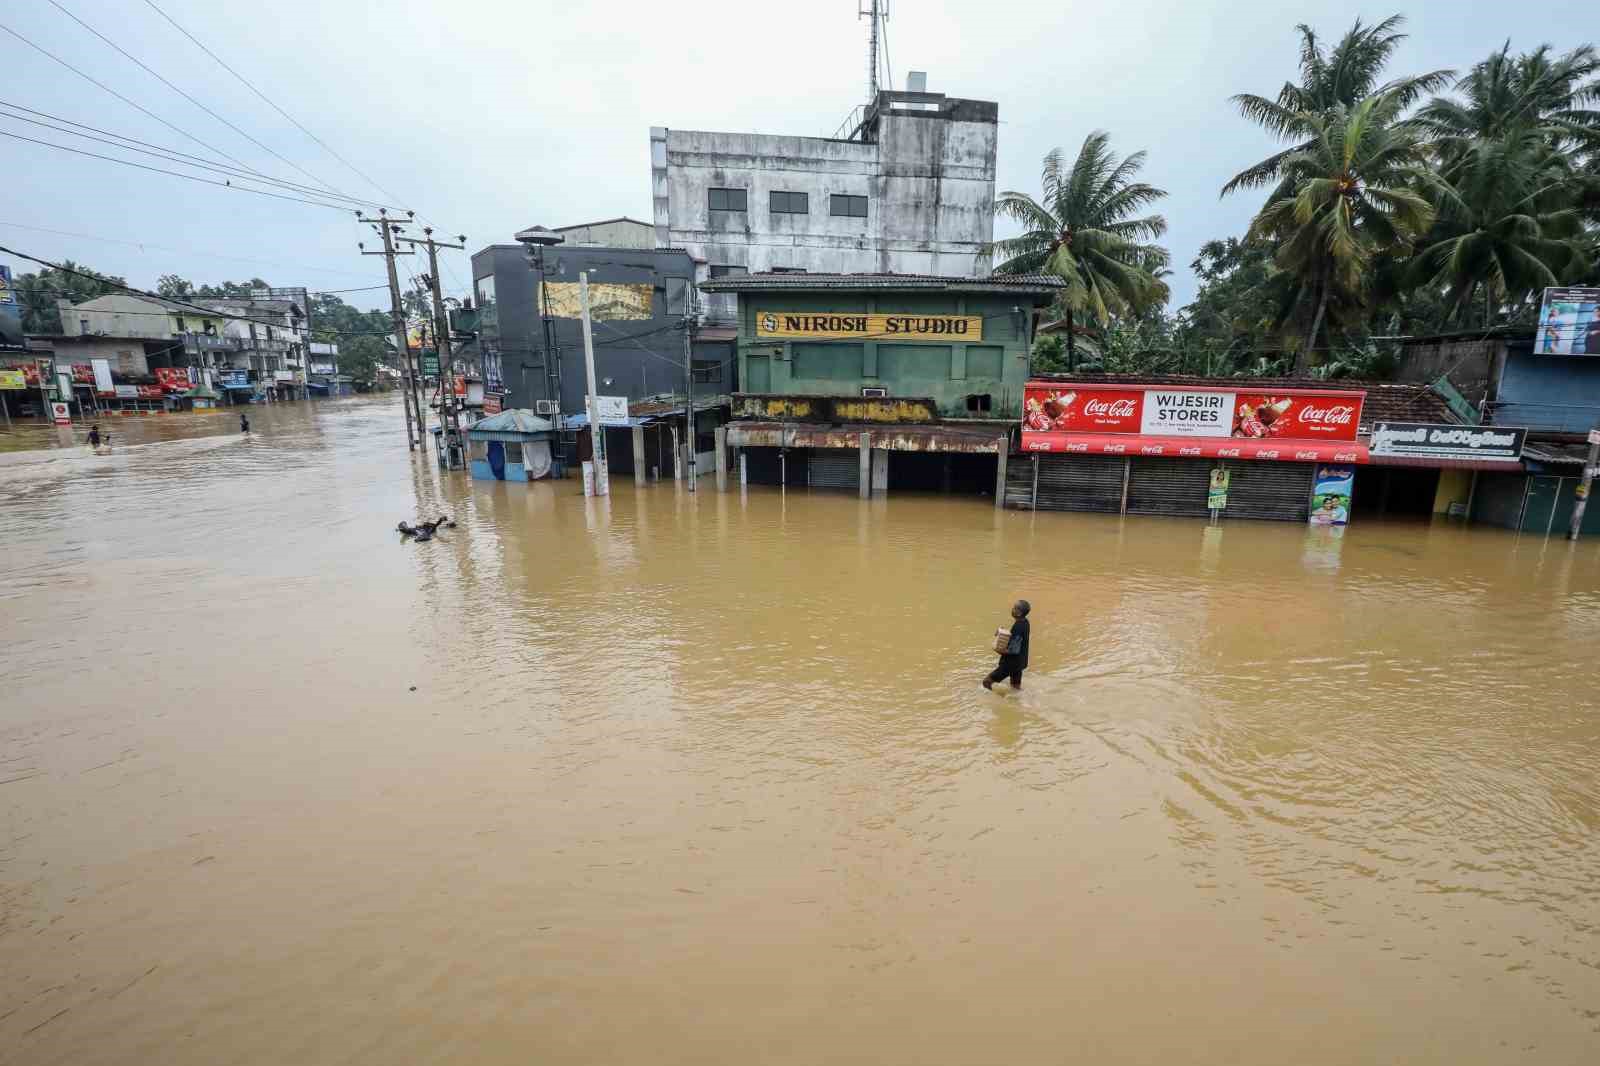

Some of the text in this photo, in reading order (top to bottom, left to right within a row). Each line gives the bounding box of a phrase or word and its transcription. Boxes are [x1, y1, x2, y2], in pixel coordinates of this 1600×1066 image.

[785, 315, 868, 332] NIROSH
[886, 317, 969, 335] STUDIO
[1084, 398, 1137, 417] Coca-Cola
[1156, 395, 1224, 408] WIJESIRI
[1158, 409, 1219, 422] STORES
[1298, 405, 1354, 424] Coca-Cola
